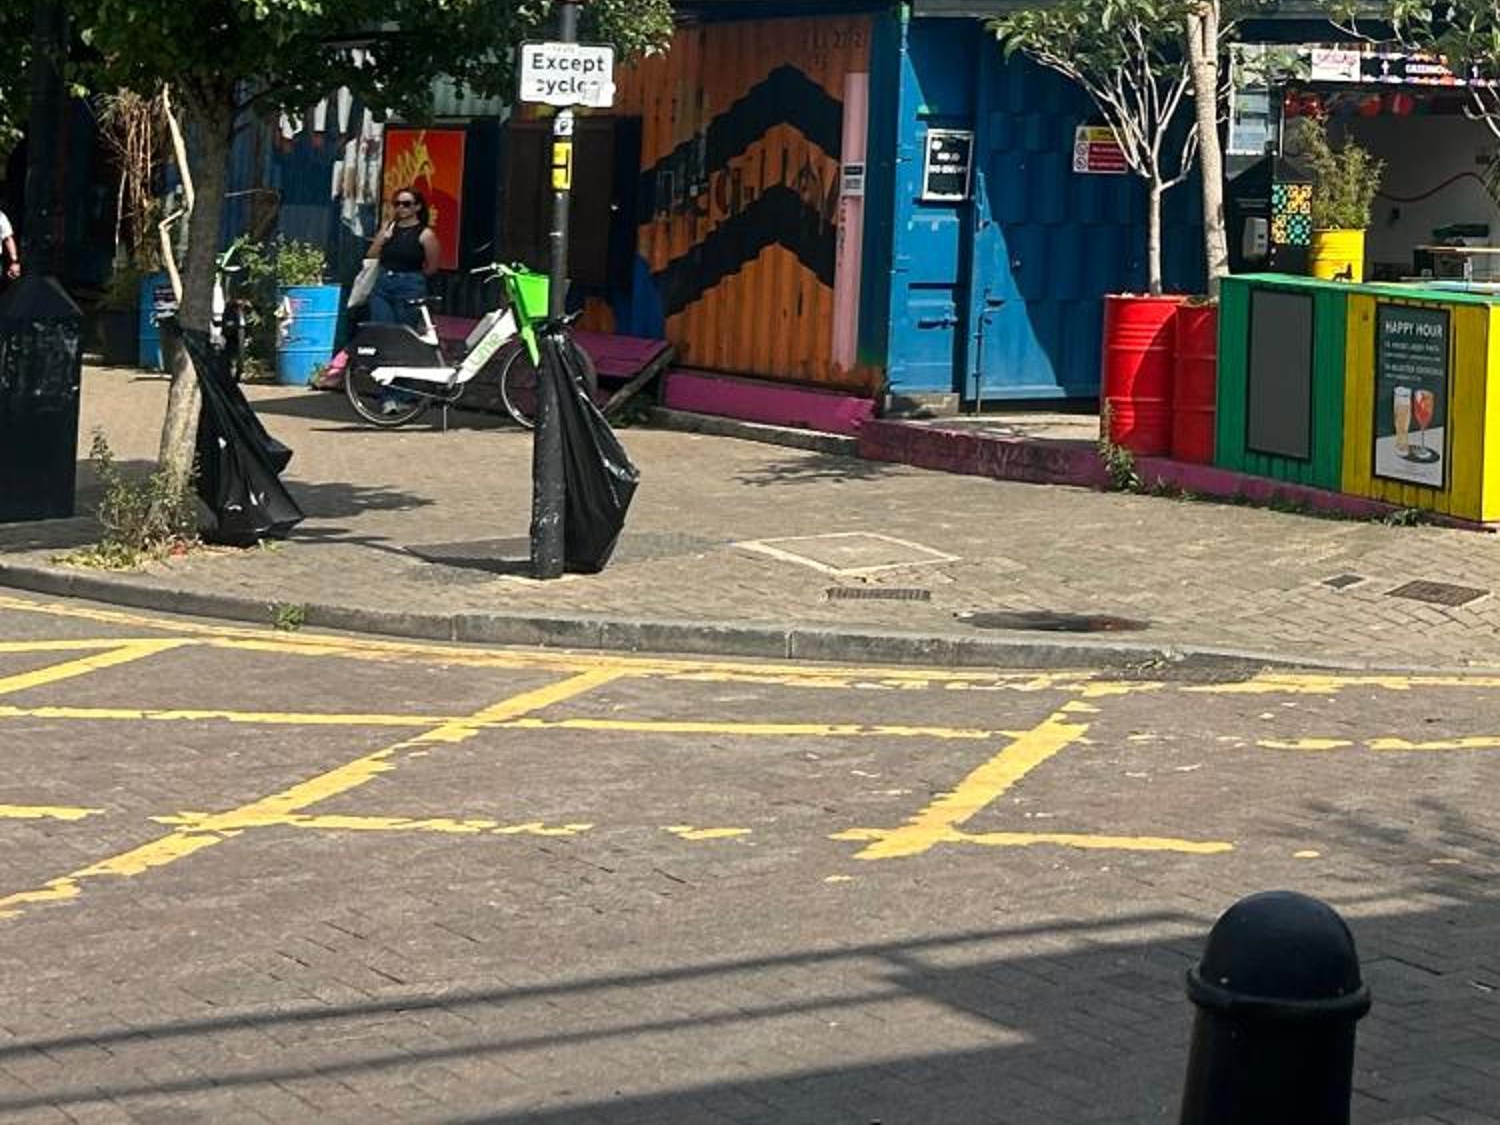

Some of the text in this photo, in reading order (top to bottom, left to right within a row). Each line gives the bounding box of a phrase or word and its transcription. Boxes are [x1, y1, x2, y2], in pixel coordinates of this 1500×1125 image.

[533, 53, 604, 74] Except
[1385, 321, 1443, 339] HAPPY HOUR
